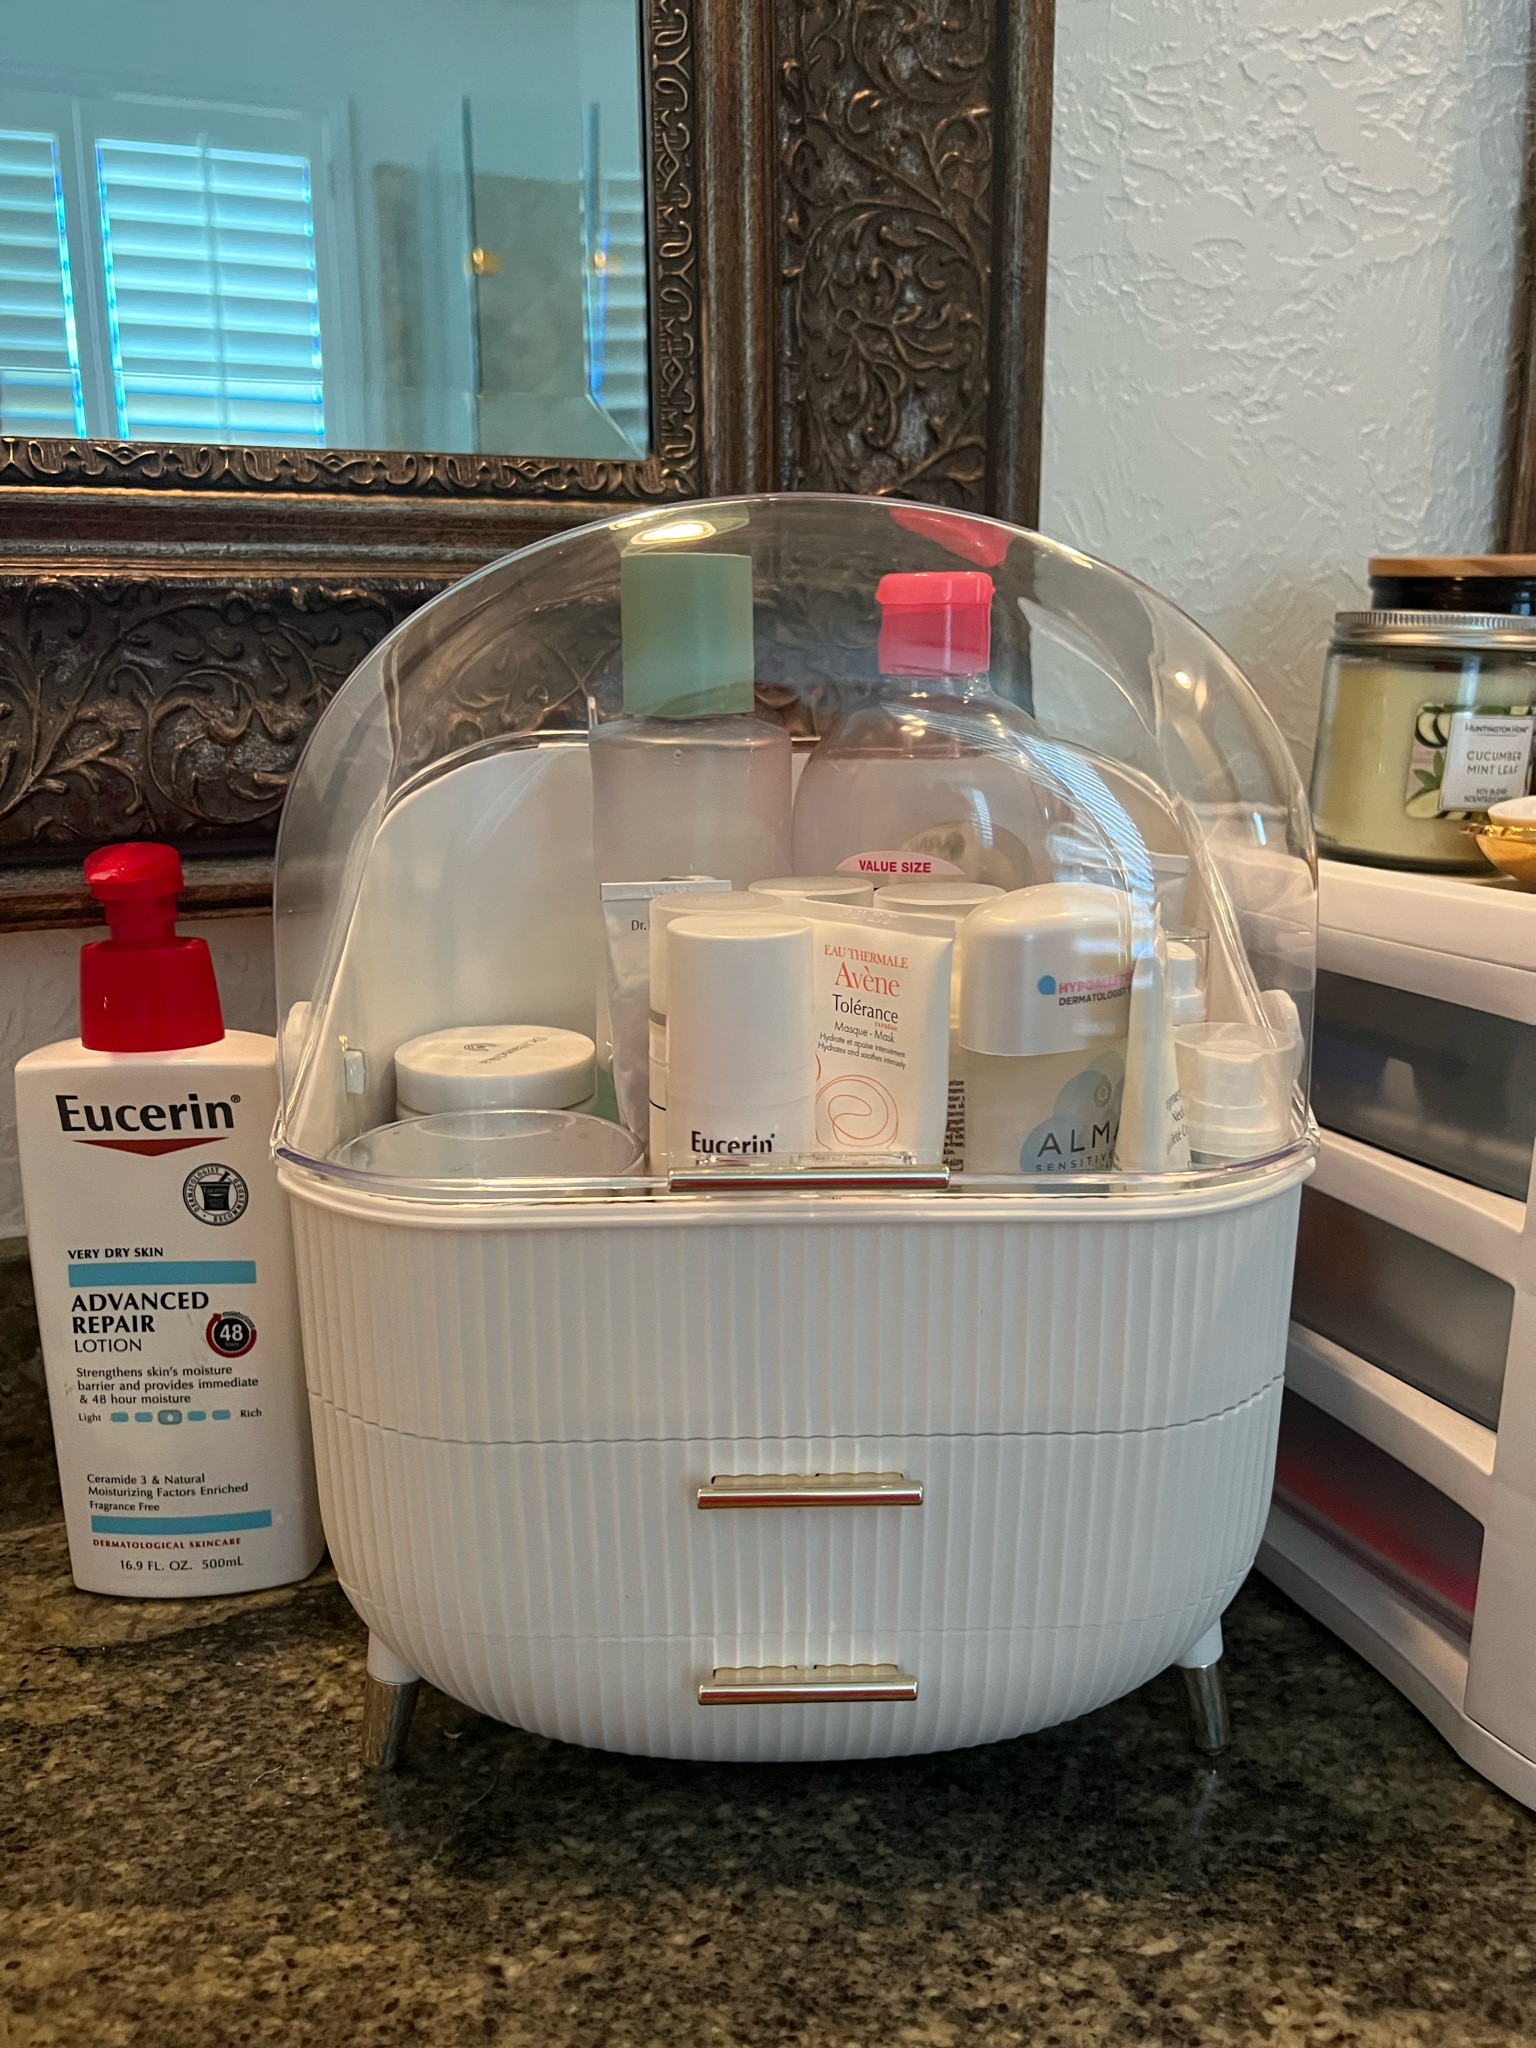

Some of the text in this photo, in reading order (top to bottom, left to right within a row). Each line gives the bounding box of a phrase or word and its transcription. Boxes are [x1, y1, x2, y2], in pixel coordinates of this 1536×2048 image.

[1466, 750, 1521, 761] CUCUMBER
[1466, 764, 1519, 775] MINT LEAF
[859, 859, 931, 873] VALUE SIZE
[631, 919, 647, 931] Dr.
[824, 944, 909, 969] EAU THERMALE
[834, 961, 900, 998] Avène
[832, 993, 899, 1024] Tolérance
[819, 1032, 845, 1044] Hydrate
[834, 1020, 868, 1038] Masque
[874, 1029, 896, 1043] Mask
[818, 1041, 846, 1054] Hydrates
[847, 1047, 860, 1057] and
[68, 1247, 163, 1259] VERY DRY SKIN
[71, 1291, 209, 1312] ADVANCED
[72, 1315, 155, 1334] REPAIR
[219, 1323, 244, 1342] 48
[75, 1338, 142, 1353] LOTION
[76, 1365, 233, 1380] Strengthens skin's moisture
[77, 1377, 259, 1393] barrier and provides immediate
[79, 1393, 191, 1404] & 48 hour moisture
[78, 1408, 262, 1423] Light Rich
[87, 1473, 205, 1485] Ceramide 3 & Natural
[88, 1482, 249, 1499] Moisturizing Factors Enriched
[89, 1500, 160, 1512] Fragrance Free
[92, 1537, 241, 1550] DERMATOLOGICAL SKINCARE
[120, 1556, 244, 1571] 16.9 FL. OZ. 500mL
